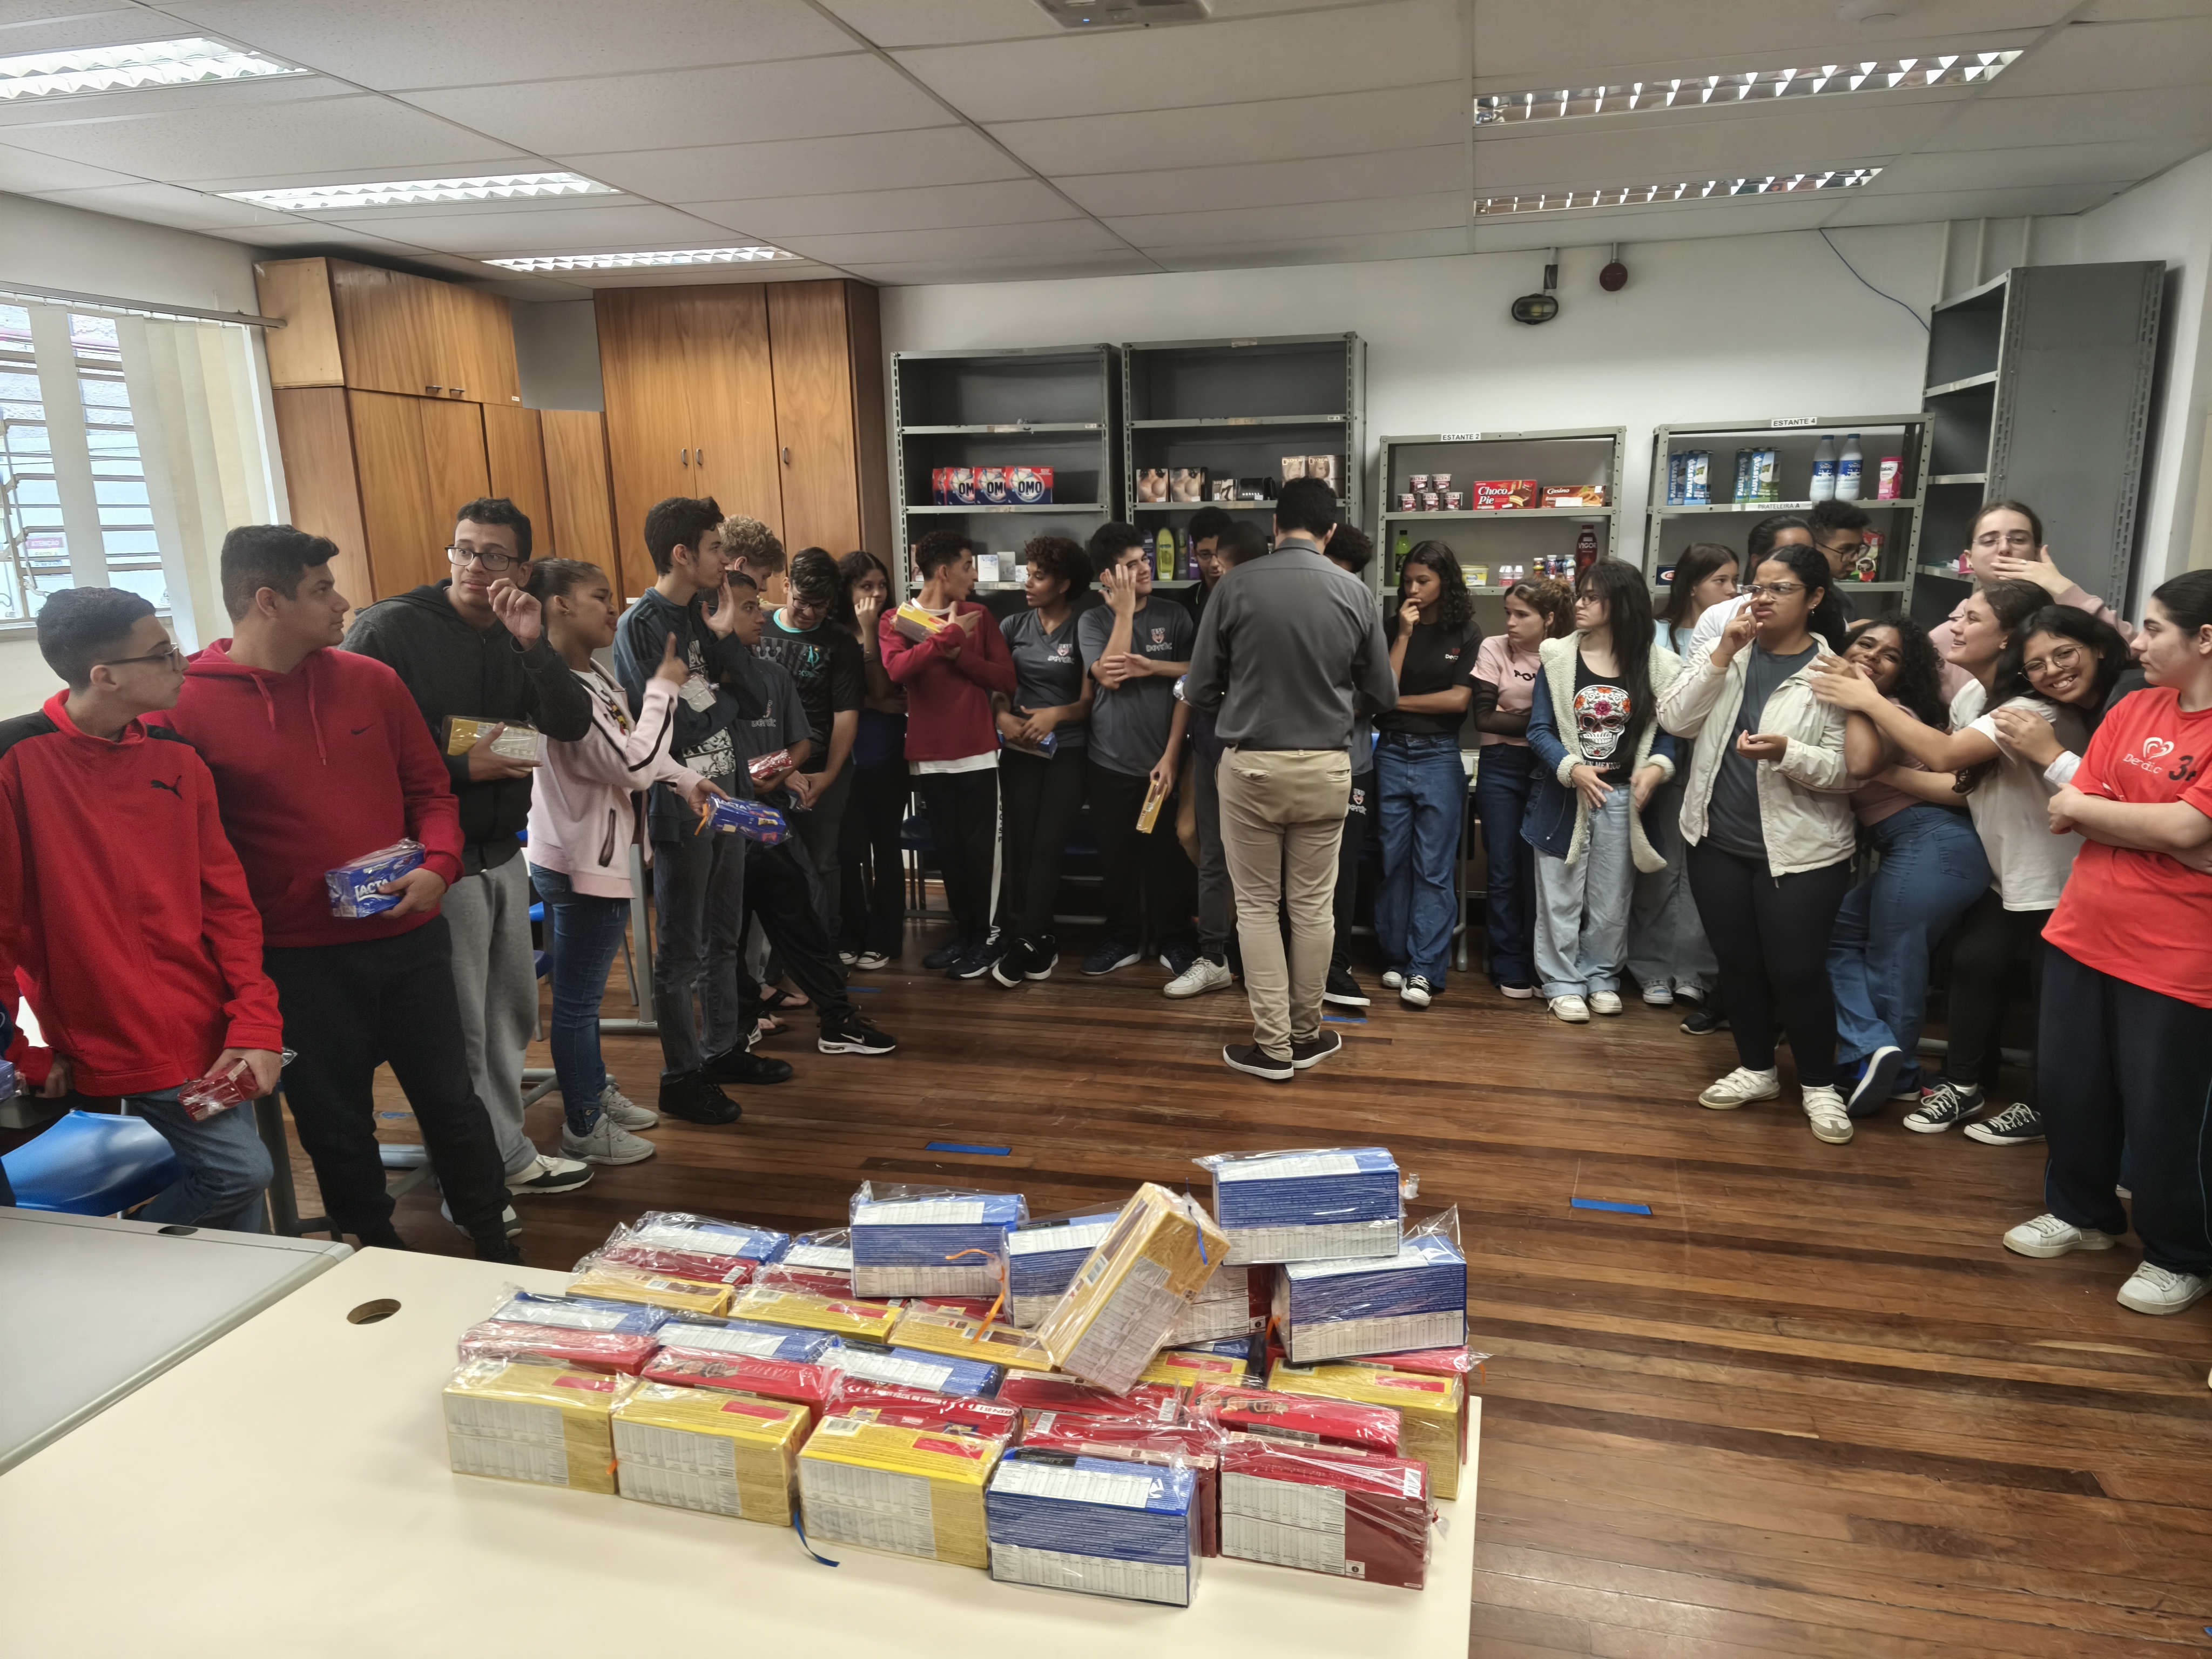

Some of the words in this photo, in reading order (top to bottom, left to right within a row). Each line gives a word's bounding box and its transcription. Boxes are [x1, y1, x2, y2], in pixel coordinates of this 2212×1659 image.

[1773, 419, 1809, 427] ESTANTE
[959, 483, 974, 495] OM
[987, 482, 1006, 495] OM
[1018, 481, 1042, 494] OMO
[1478, 487, 1508, 495] Choco
[1478, 496, 1494, 504] Pie
